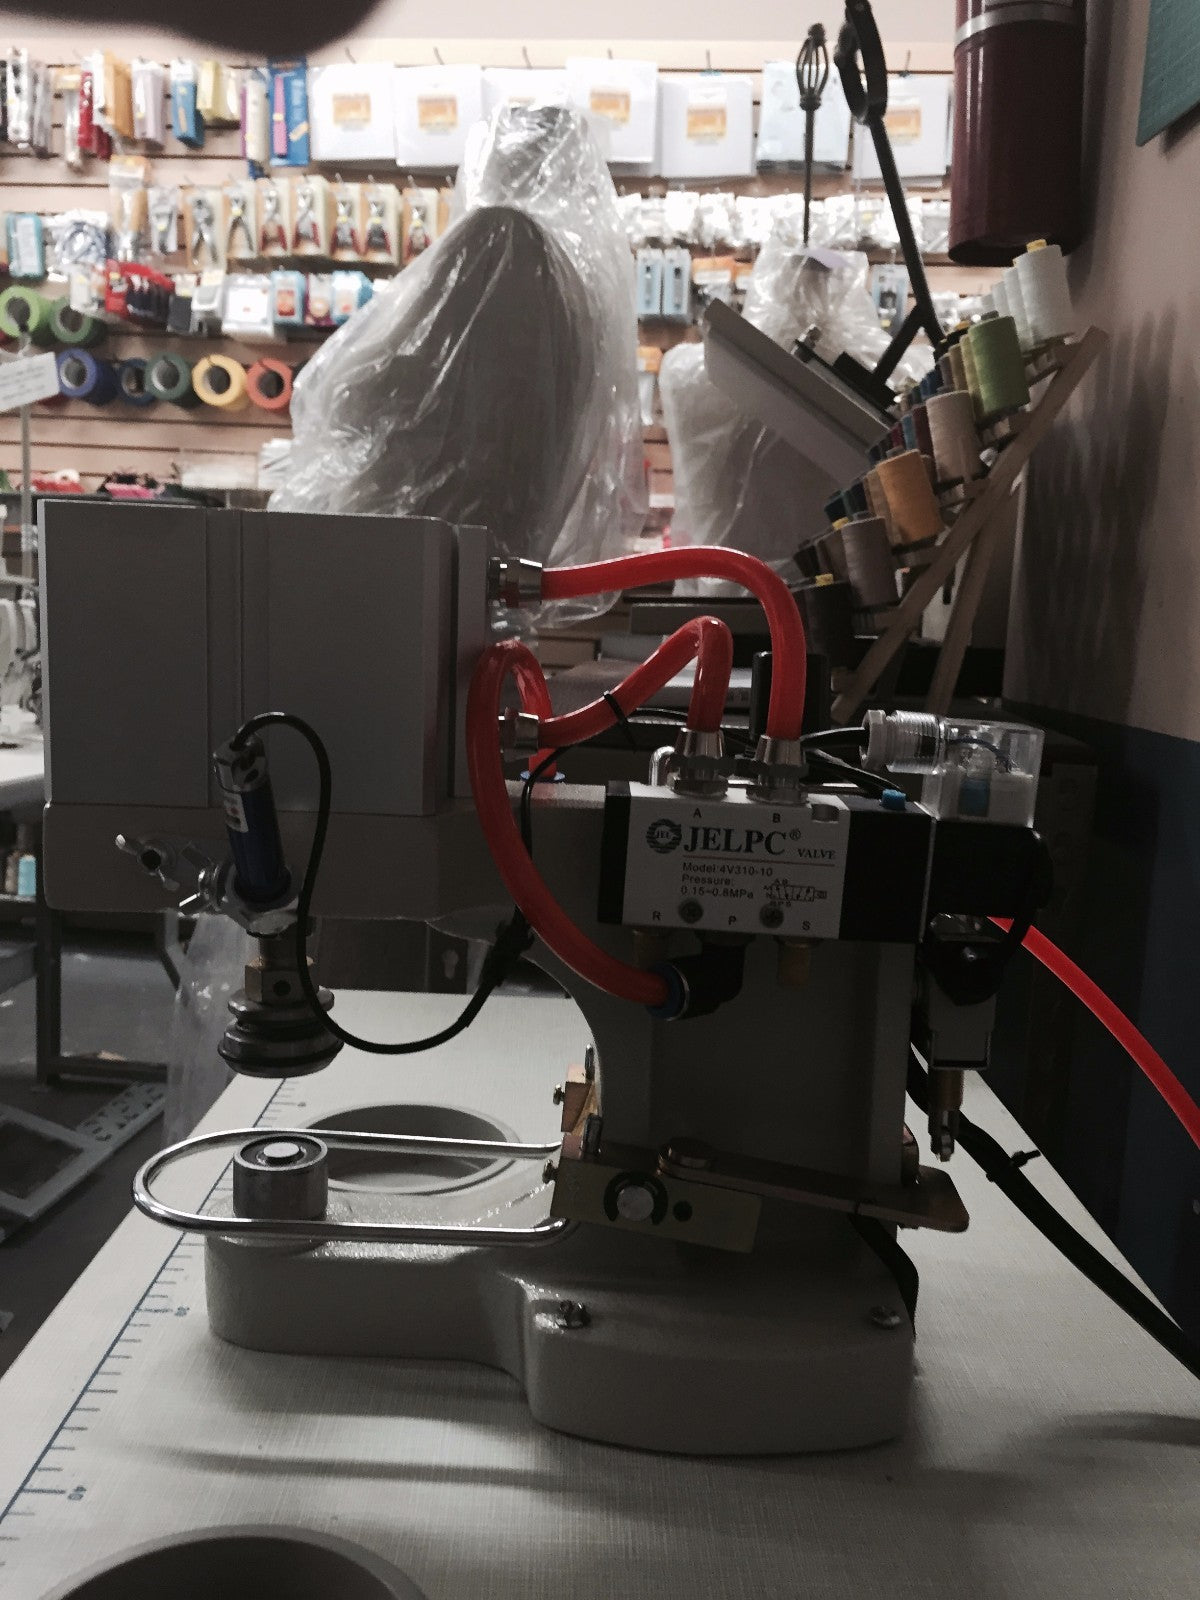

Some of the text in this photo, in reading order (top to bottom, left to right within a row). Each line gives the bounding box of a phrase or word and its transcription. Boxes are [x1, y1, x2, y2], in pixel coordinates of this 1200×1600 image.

[692, 807, 781, 823] A B
[797, 848, 837, 860] VALVE
[652, 910, 661, 921] R
[727, 915, 737, 926] P
[801, 920, 811, 931] S
